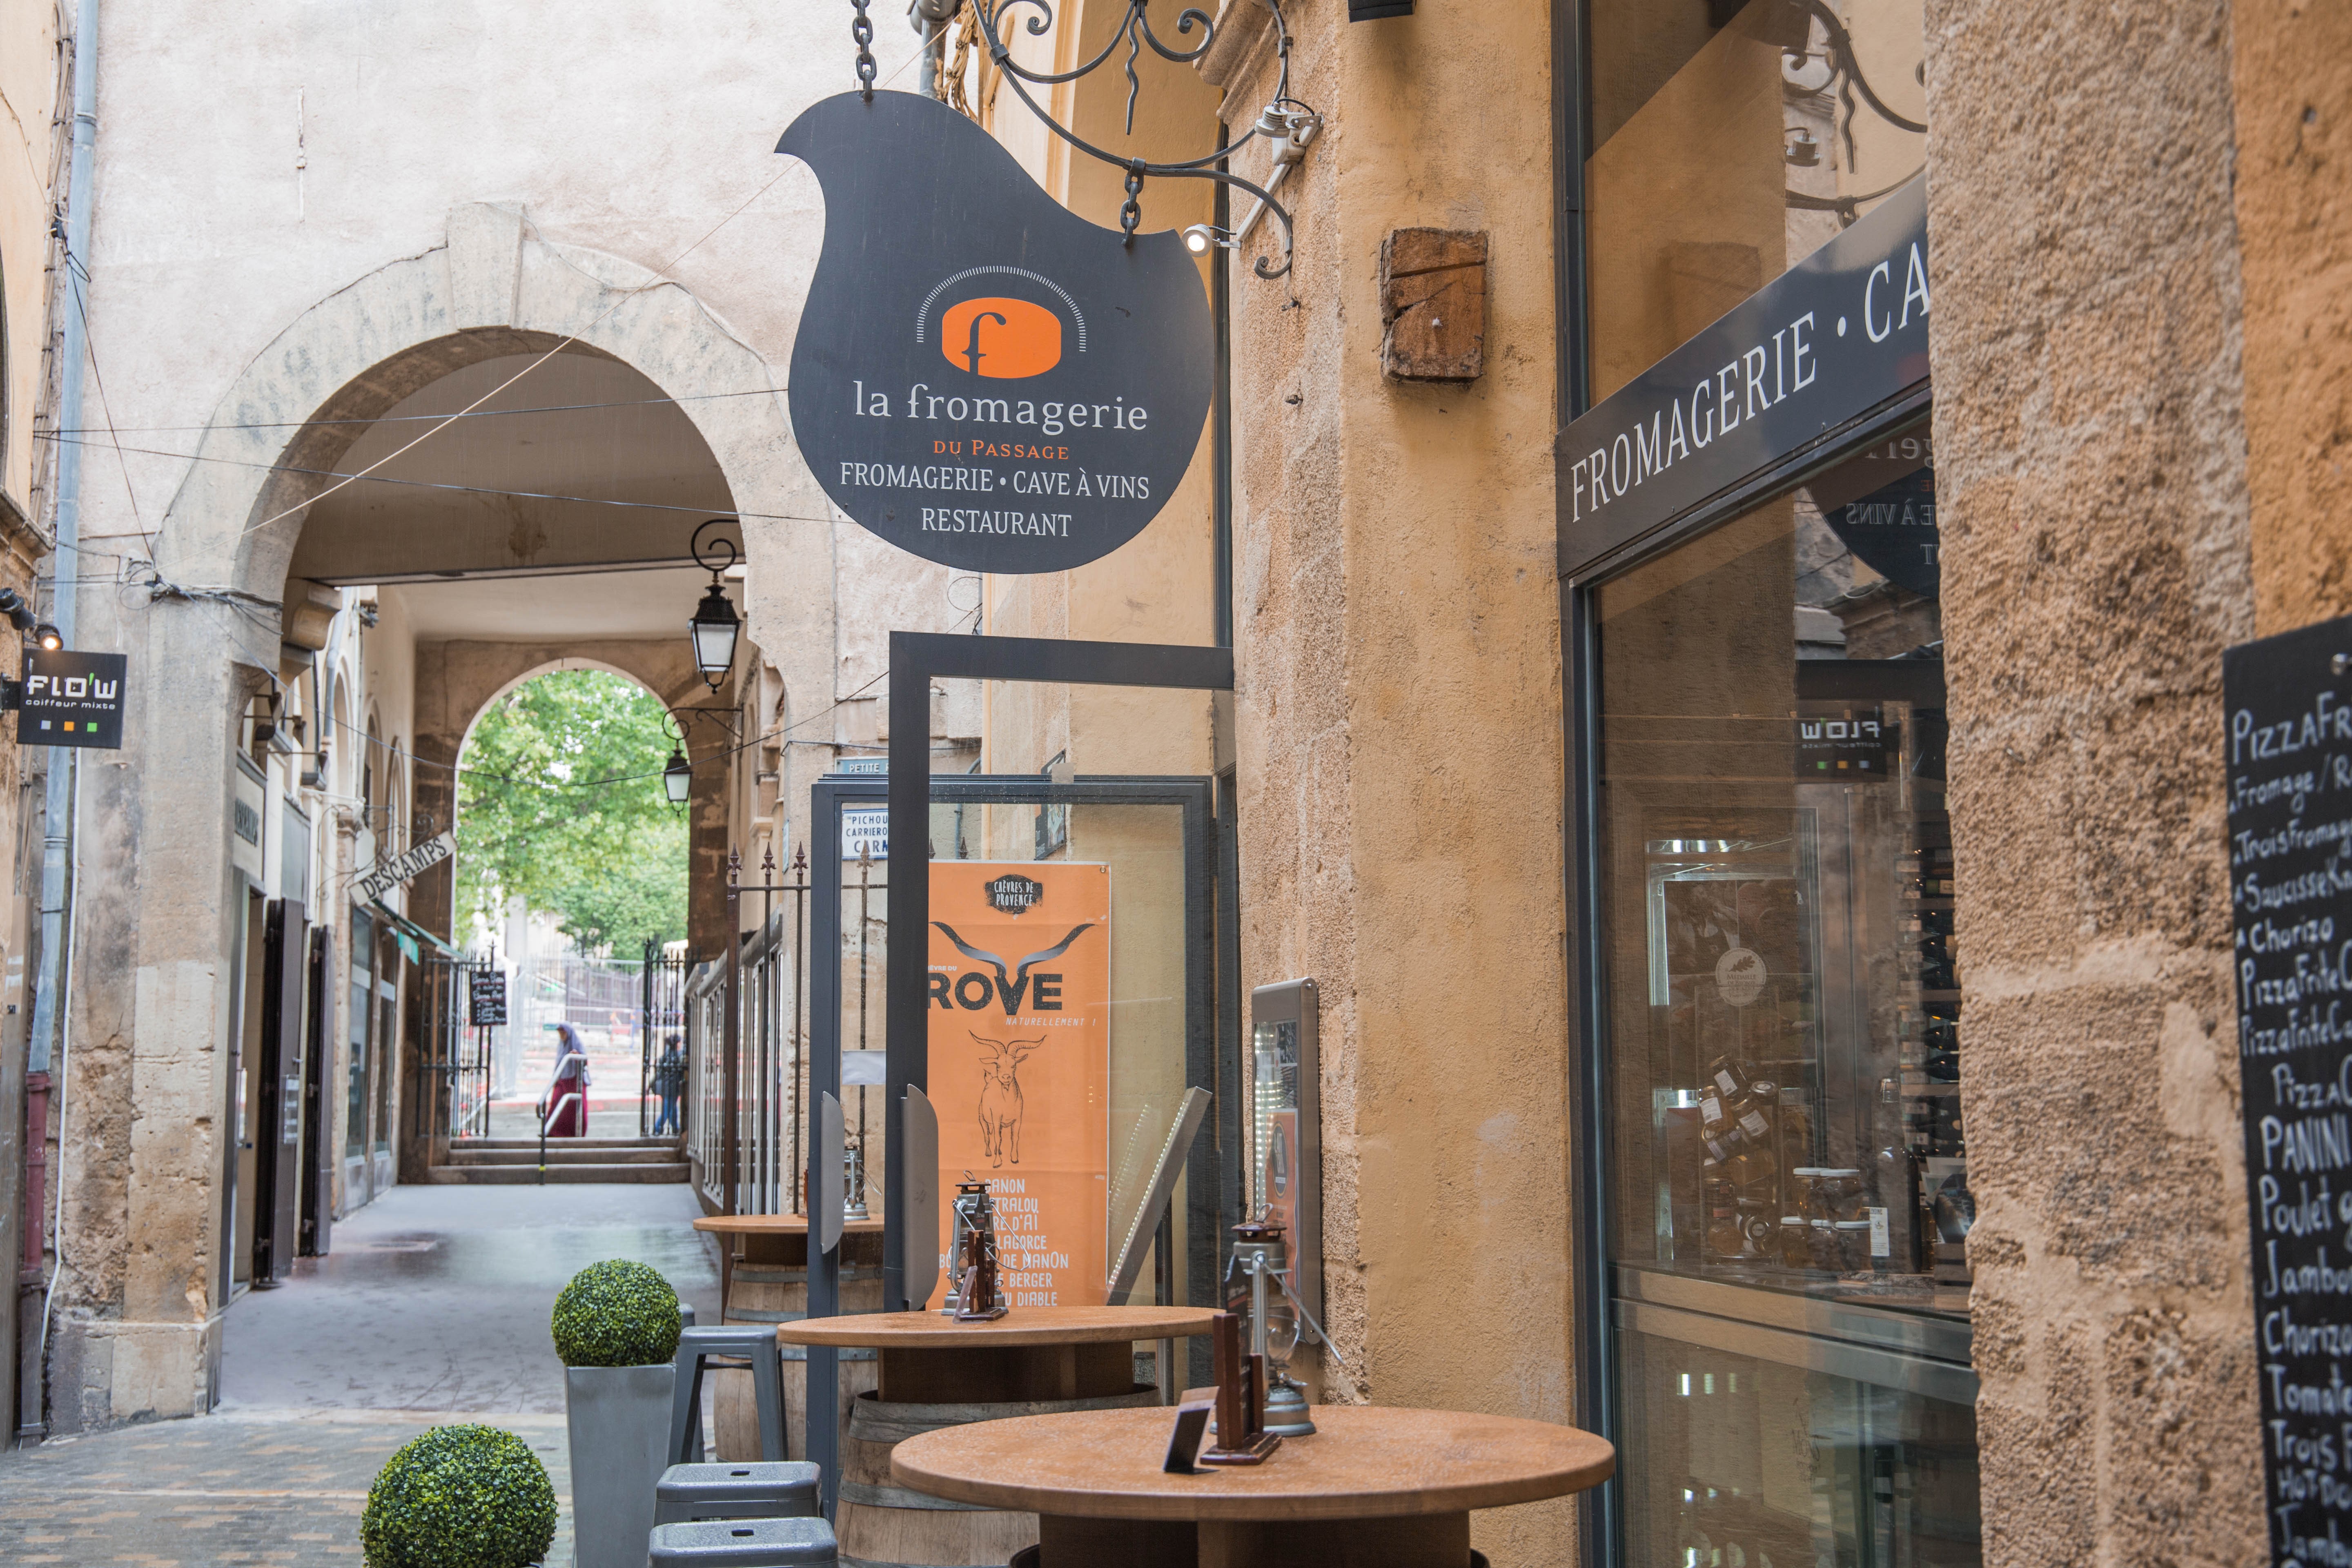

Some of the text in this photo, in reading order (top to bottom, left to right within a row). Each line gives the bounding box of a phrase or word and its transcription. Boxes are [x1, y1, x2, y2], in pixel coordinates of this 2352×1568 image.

[1571, 242, 1931, 523] FROMAGERIE CA
[853, 380, 1147, 436] la fromagerie
[840, 462, 1149, 499] FROMAGERIE CAVE À VINS
[922, 508, 1071, 537] RESTAURANT
[25, 699, 77, 707] coiffeur
[849, 763, 879, 773] PETITE
[853, 815, 888, 824] PICHOU
[846, 827, 887, 836] CARRIERO
[360, 836, 447, 899] DESCAMPS
[1026, 882, 1033, 893] DE
[996, 894, 1033, 906] PROVENCE
[2249, 916, 2334, 953] Chorizo
[928, 971, 1062, 1016] ROVE
[1006, 1018, 1085, 1027] NATURELLEMENT
[990, 1197, 1038, 1213] TRALOU
[997, 1235, 1047, 1250] LAGORCE
[1003, 1252, 1069, 1269] DE MANON
[1010, 1273, 1053, 1287] BERGER
[1017, 1292, 1057, 1306] DIABLE
